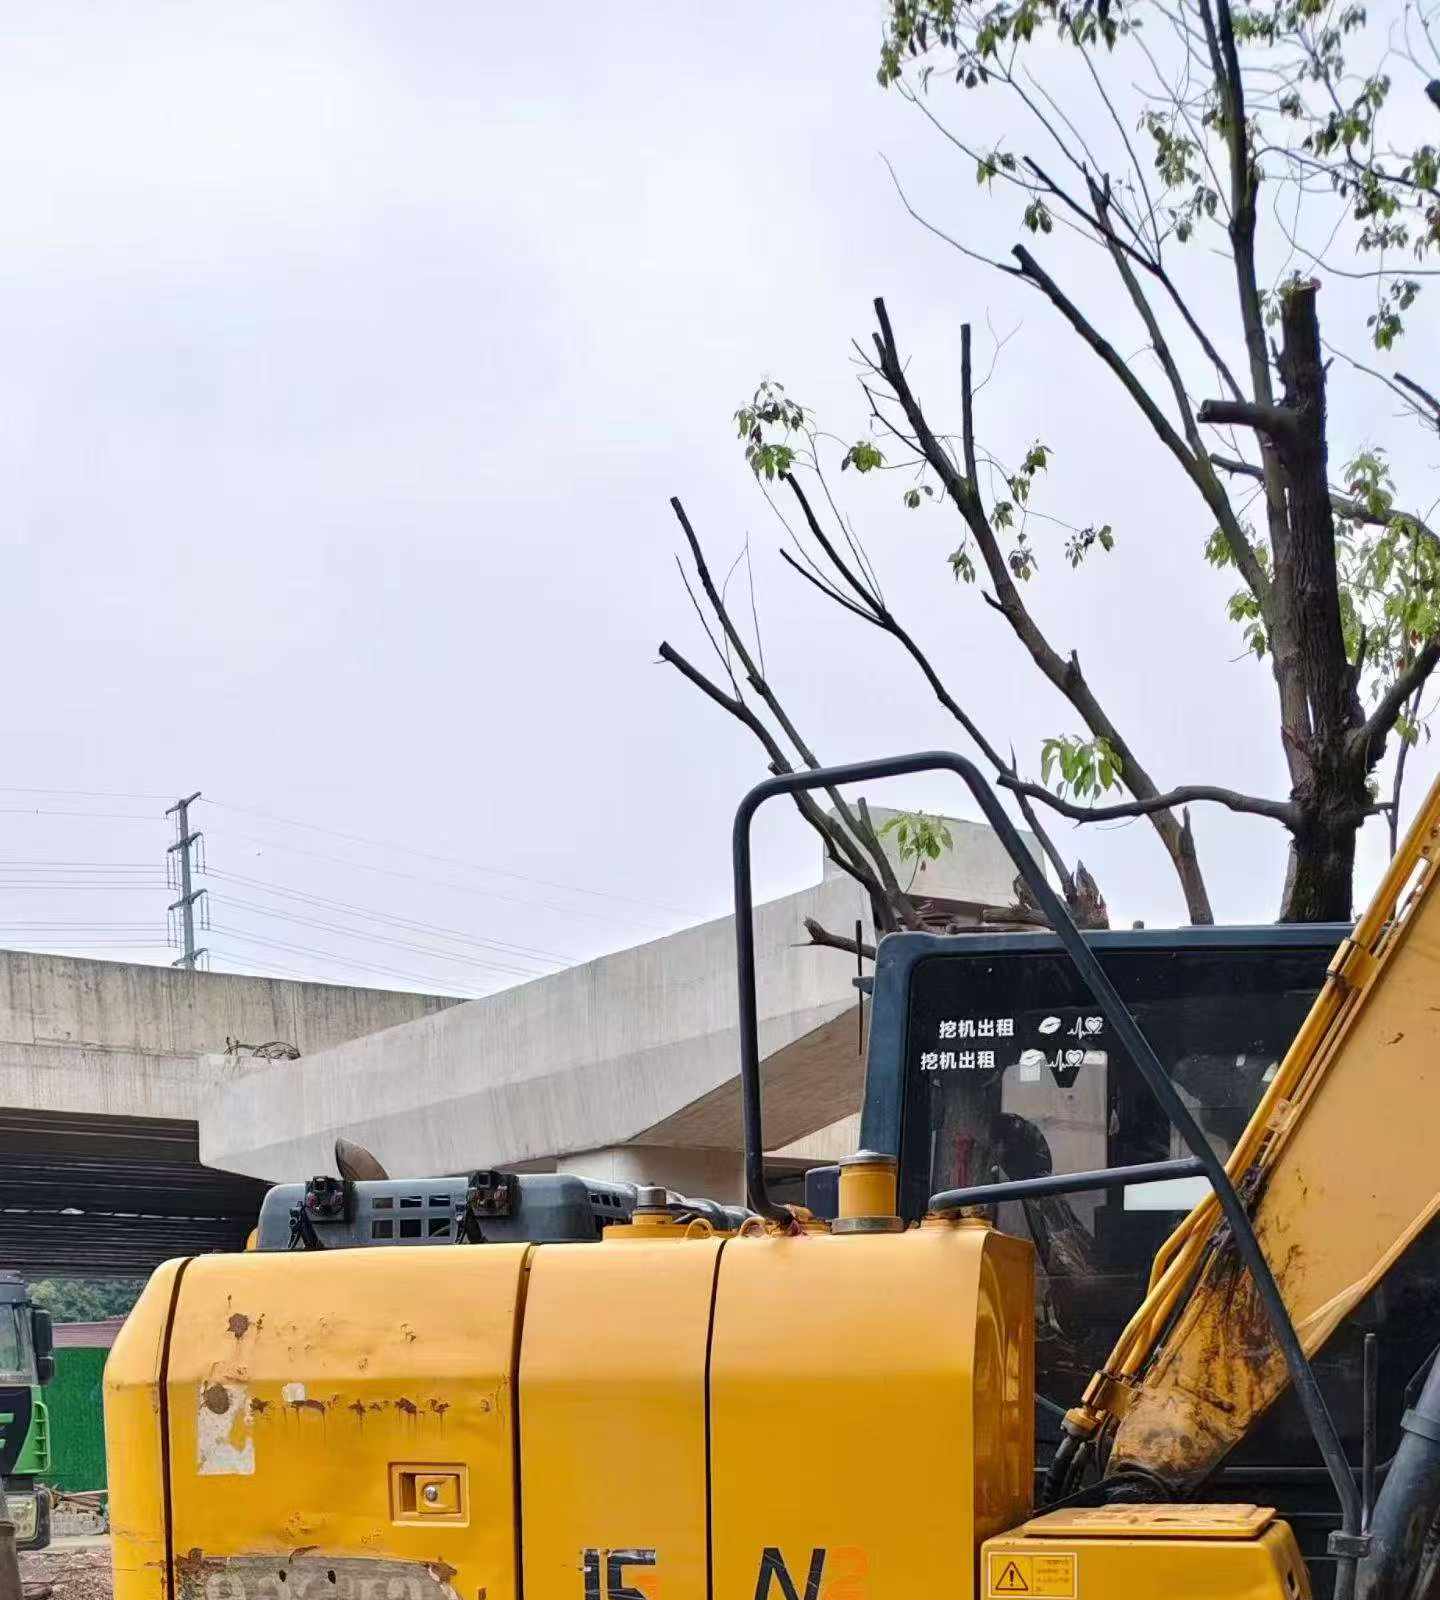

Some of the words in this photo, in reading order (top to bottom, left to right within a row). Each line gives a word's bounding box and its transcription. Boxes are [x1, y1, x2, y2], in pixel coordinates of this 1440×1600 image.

[938, 1018, 1015, 1039] 挖机出租
[920, 1050, 995, 1071] 挖机出租
